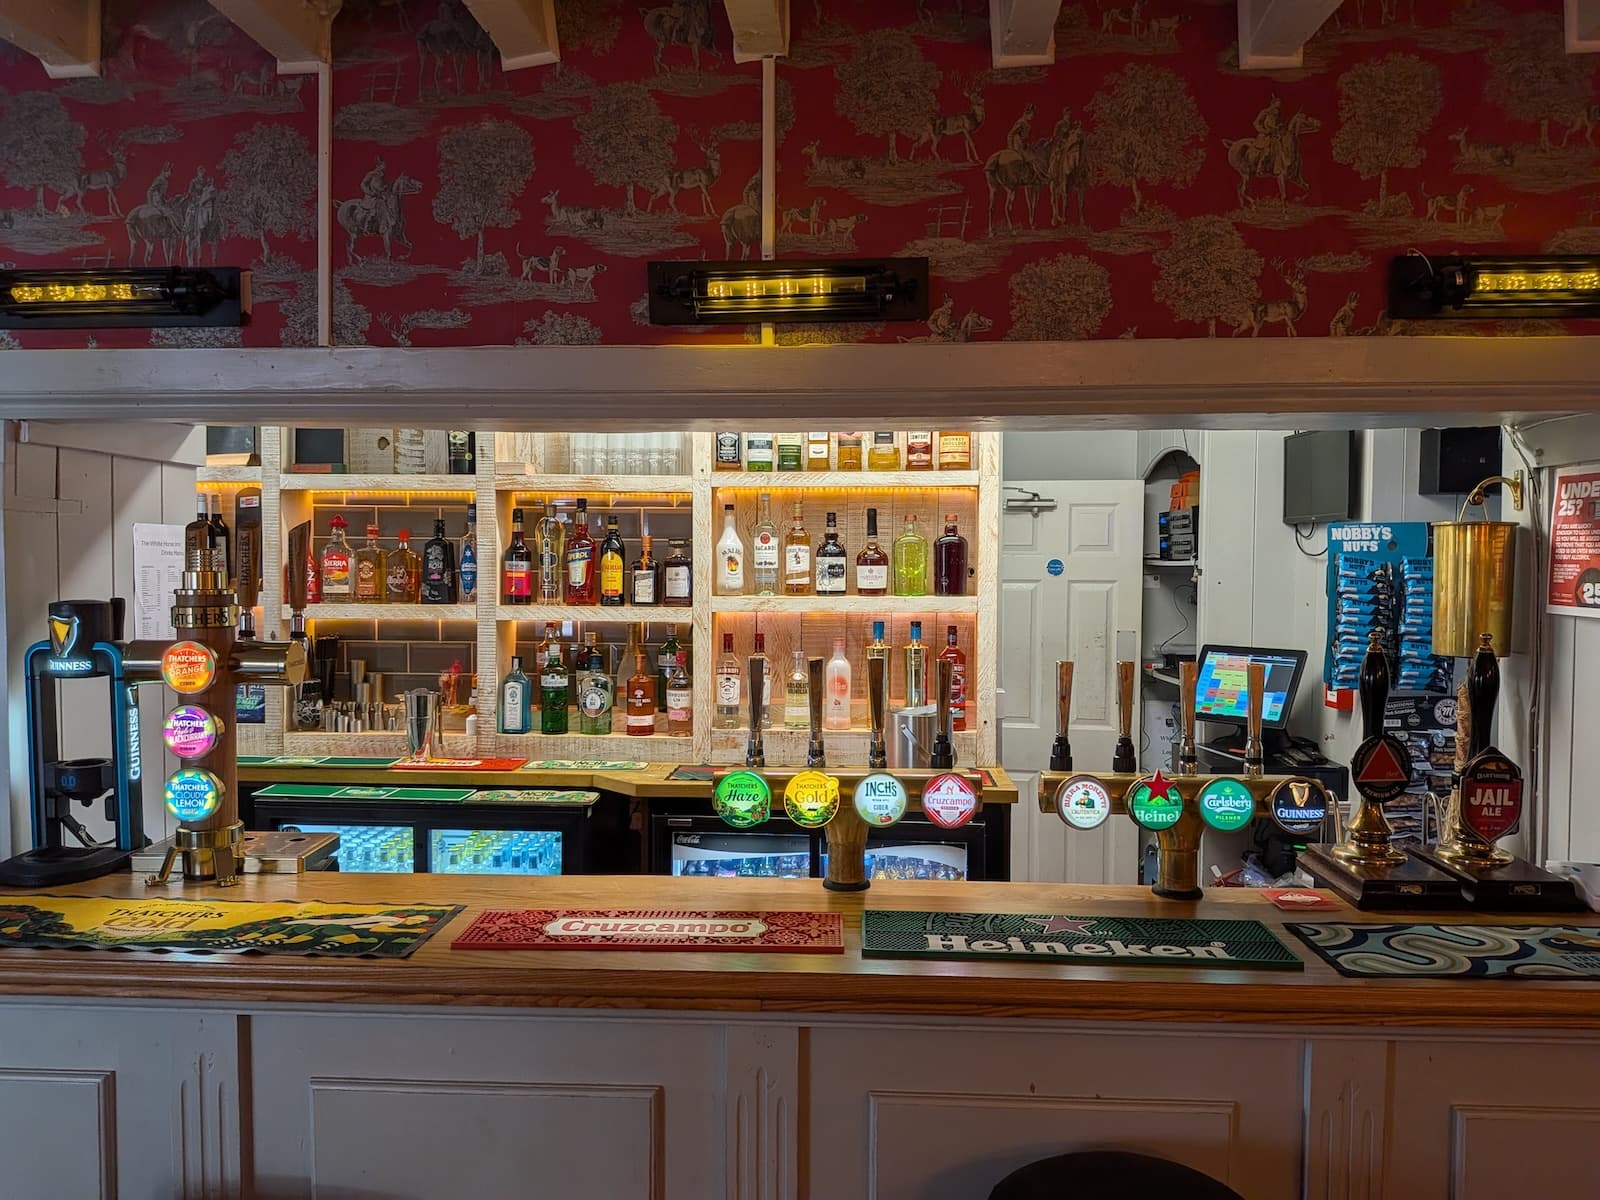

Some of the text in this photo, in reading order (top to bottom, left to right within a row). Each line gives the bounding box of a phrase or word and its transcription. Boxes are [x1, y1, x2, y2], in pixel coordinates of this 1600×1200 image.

[1558, 499, 1583, 516] 25?
[1331, 525, 1393, 540] NOBBY'S
[1343, 541, 1379, 552] NUTS
[323, 559, 347, 567] SIERRA
[168, 654, 207, 663] THATCHERS
[171, 720, 208, 728] THATCHERS
[129, 706, 141, 780] GUINNESS
[172, 783, 209, 792] THATCHERS
[865, 781, 897, 797] INCH'S
[175, 791, 205, 799] CLOUDY
[724, 788, 761, 802] Haze
[794, 790, 828, 804] Gold
[927, 795, 973, 807] Cruzcampo
[1064, 783, 1107, 809] BIRRA MORETTI
[1470, 788, 1514, 807] JAIL
[175, 800, 205, 808] LEMON
[1204, 794, 1252, 813] Carlsberg
[1277, 808, 1325, 820] GUINNESS
[1481, 807, 1502, 817] ALE
[109, 908, 226, 919] THATCHERS
[103, 916, 200, 930] Gold
[561, 918, 752, 936] Cruzcampo
[923, 934, 1237, 959] Heineken
